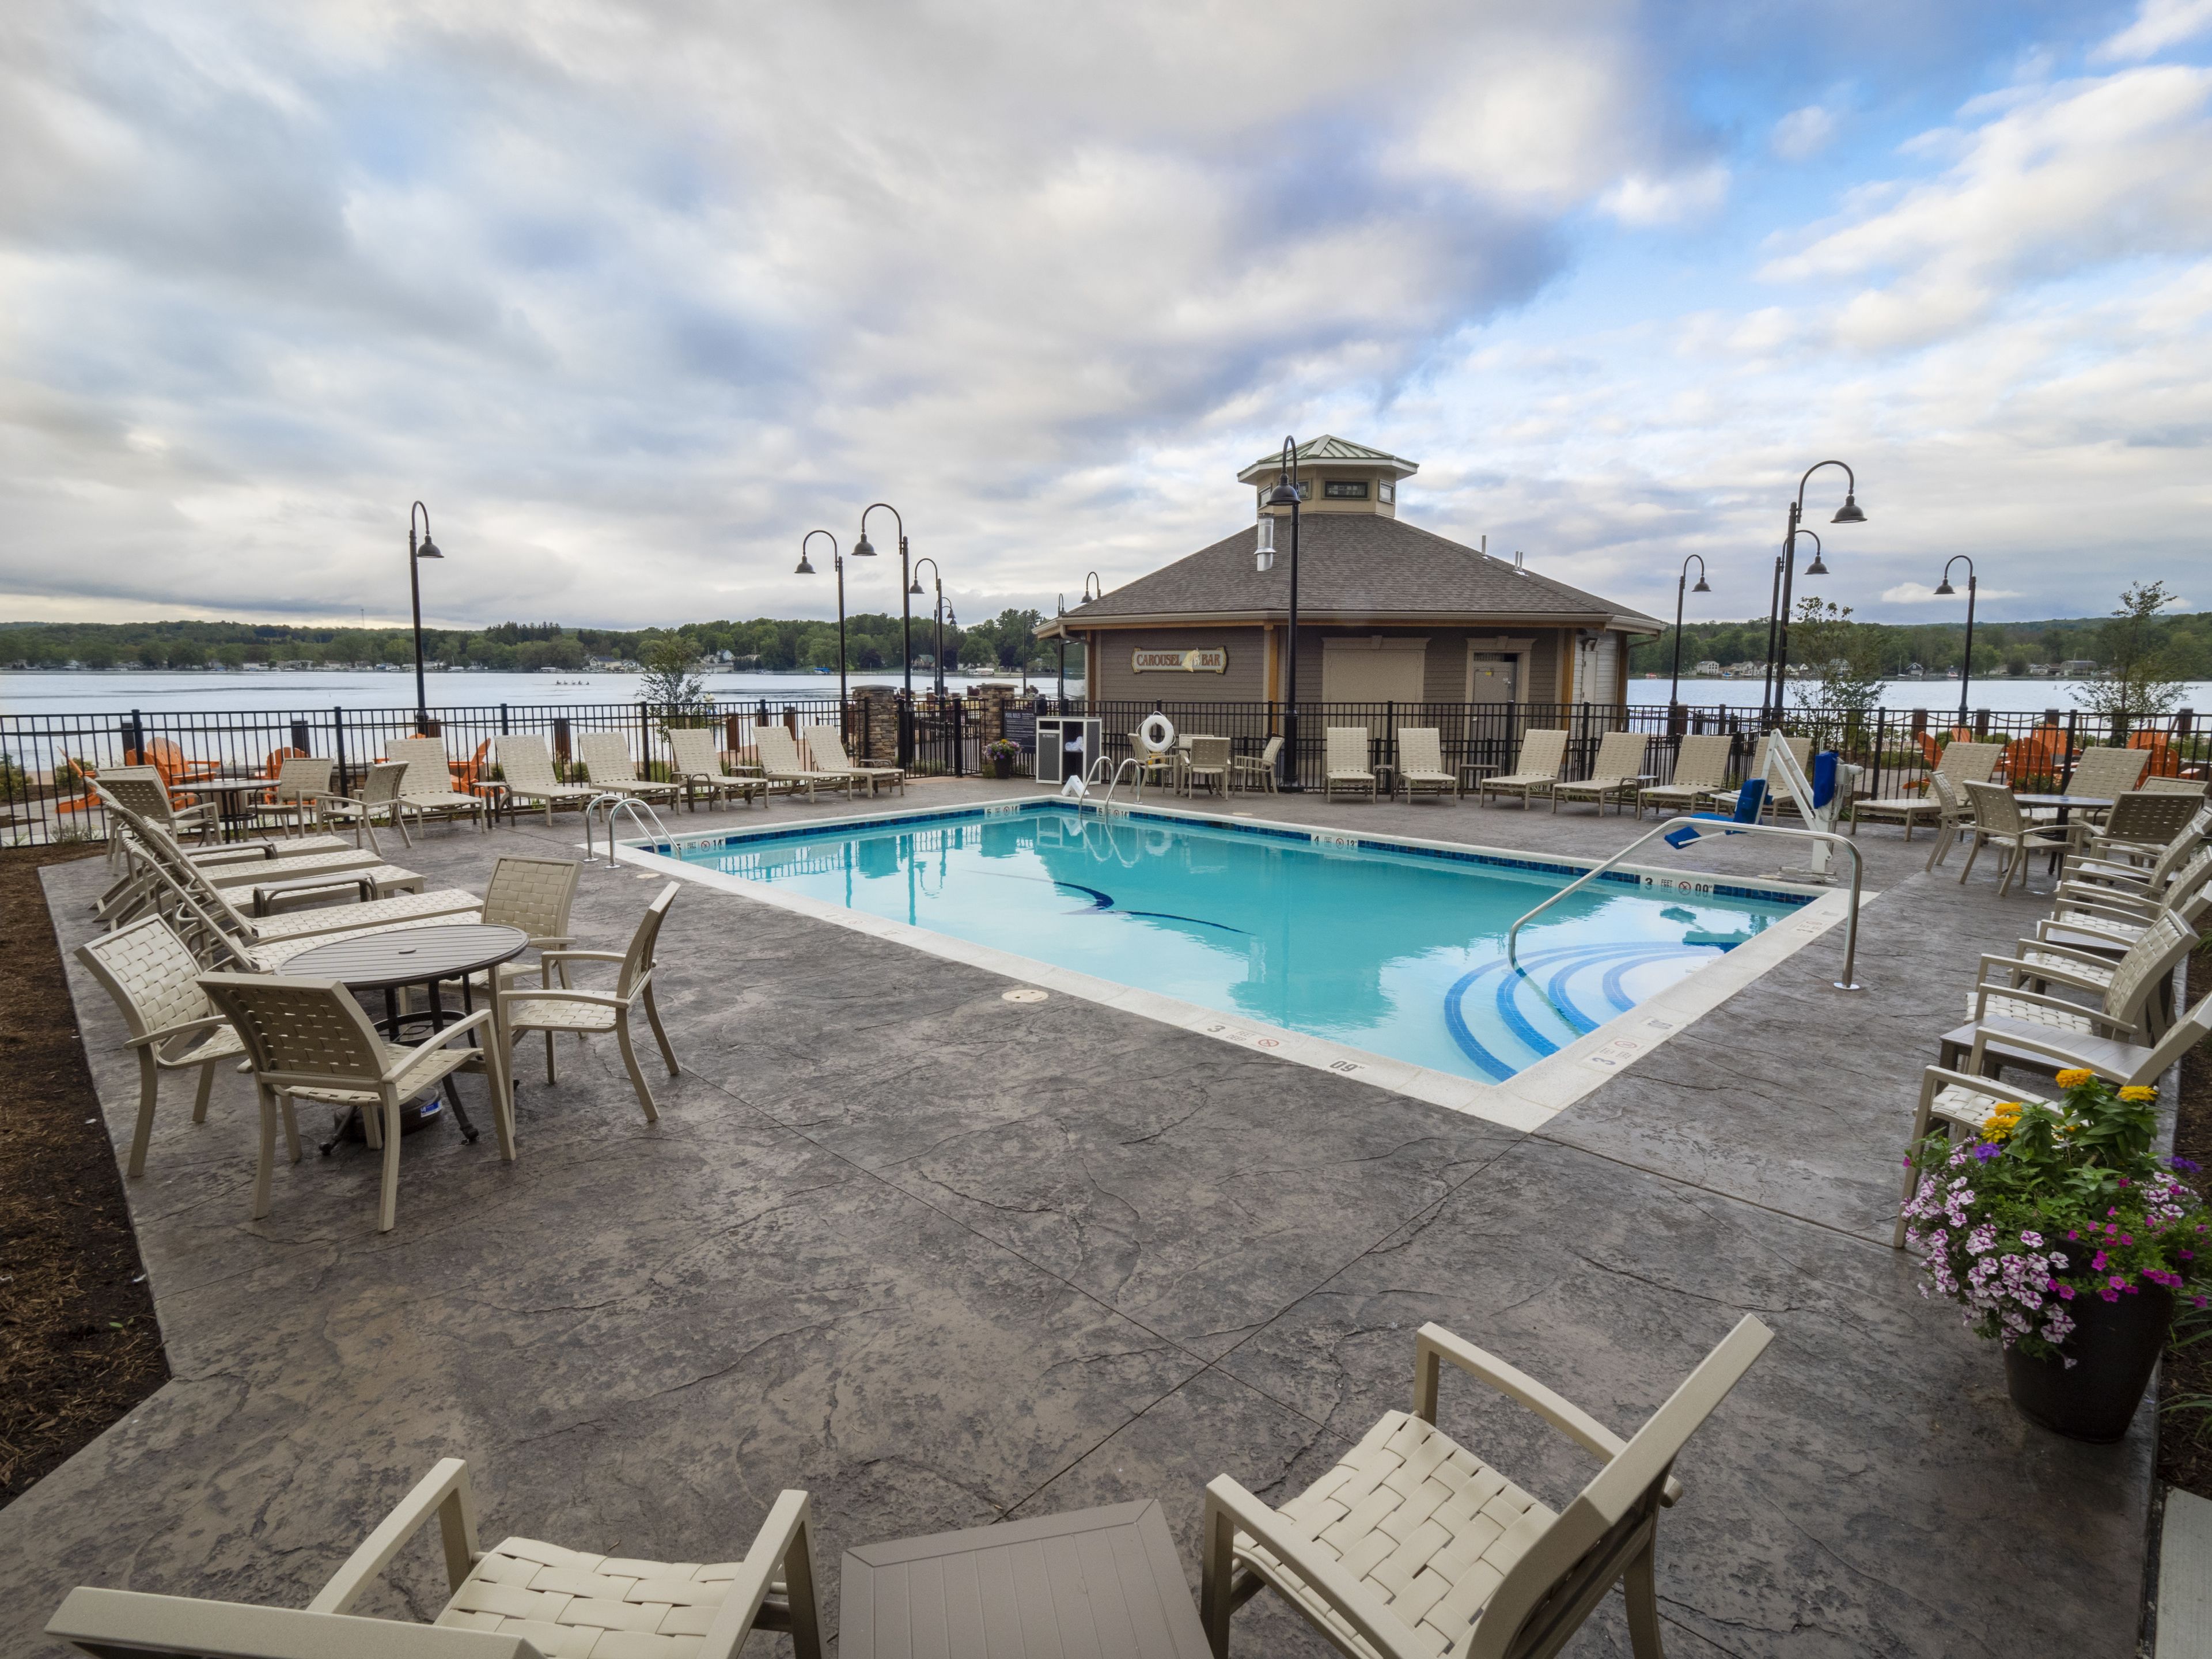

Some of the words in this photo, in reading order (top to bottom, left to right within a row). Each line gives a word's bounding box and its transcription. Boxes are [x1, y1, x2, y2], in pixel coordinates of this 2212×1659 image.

[1137, 654, 1181, 666] CAROUSEL
[1202, 654, 1220, 666] BAR
[1645, 877, 1653, 885] 3
